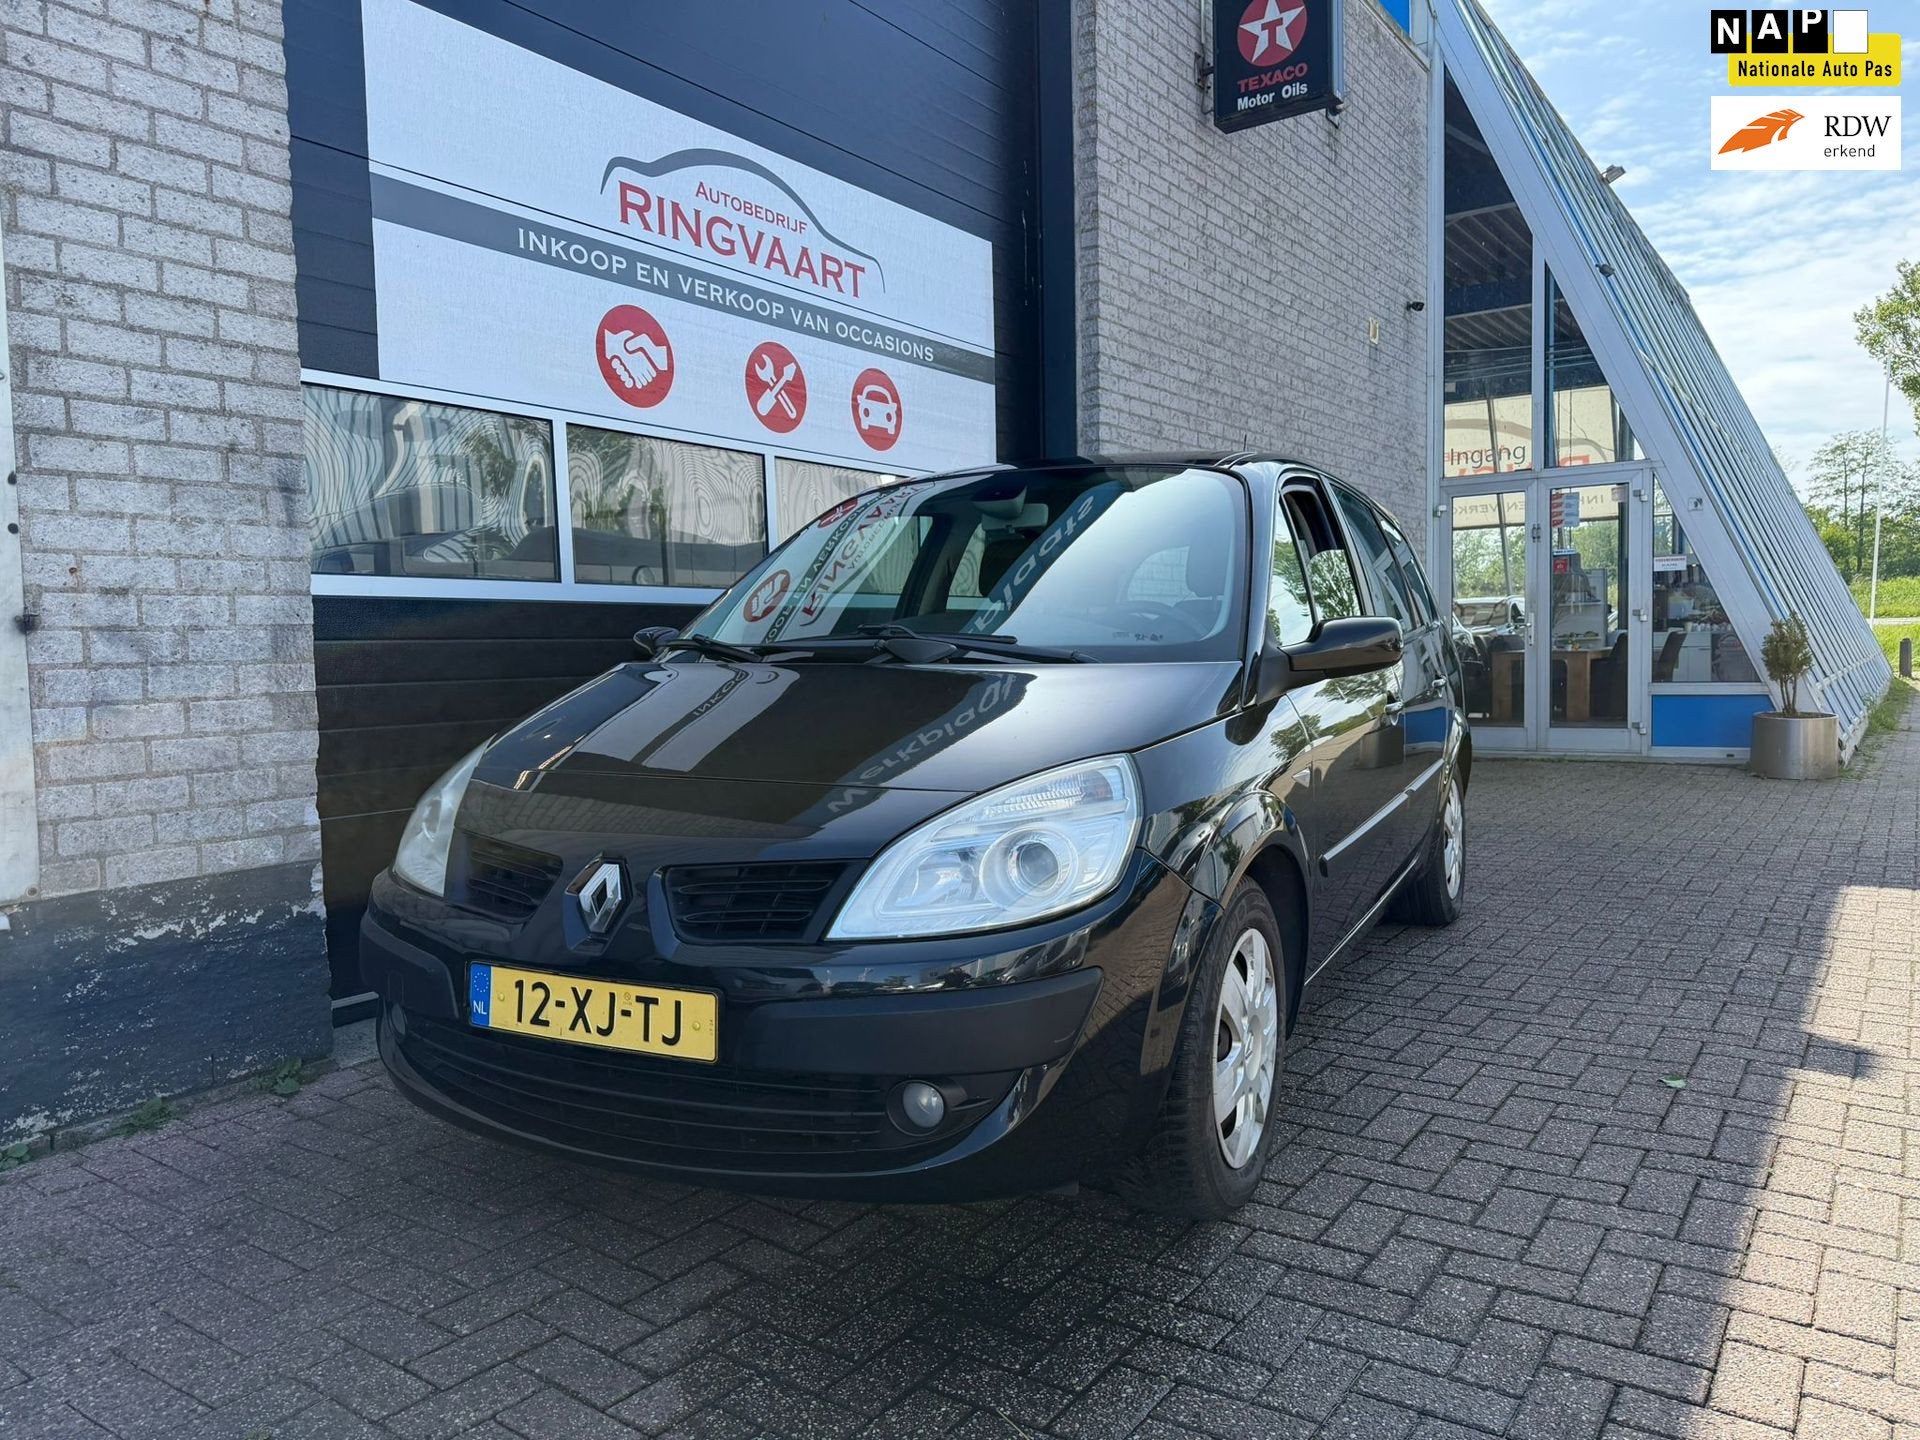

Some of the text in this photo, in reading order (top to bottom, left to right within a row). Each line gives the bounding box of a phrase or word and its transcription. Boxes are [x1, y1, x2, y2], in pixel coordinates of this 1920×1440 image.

[1237, 62, 1308, 93] TEXACO
[1237, 82, 1308, 112] Motor Oils
[695, 181, 808, 236] AUTOBEDRIJF
[617, 180, 866, 299] RINGVAART
[518, 227, 935, 363] INKOOP EN VERKOOP VAN OCCASIONS
[1450, 443, 1527, 469] Ingang
[473, 1000, 488, 1015] NL
[514, 979, 682, 1047] 12-XJ-TJ
